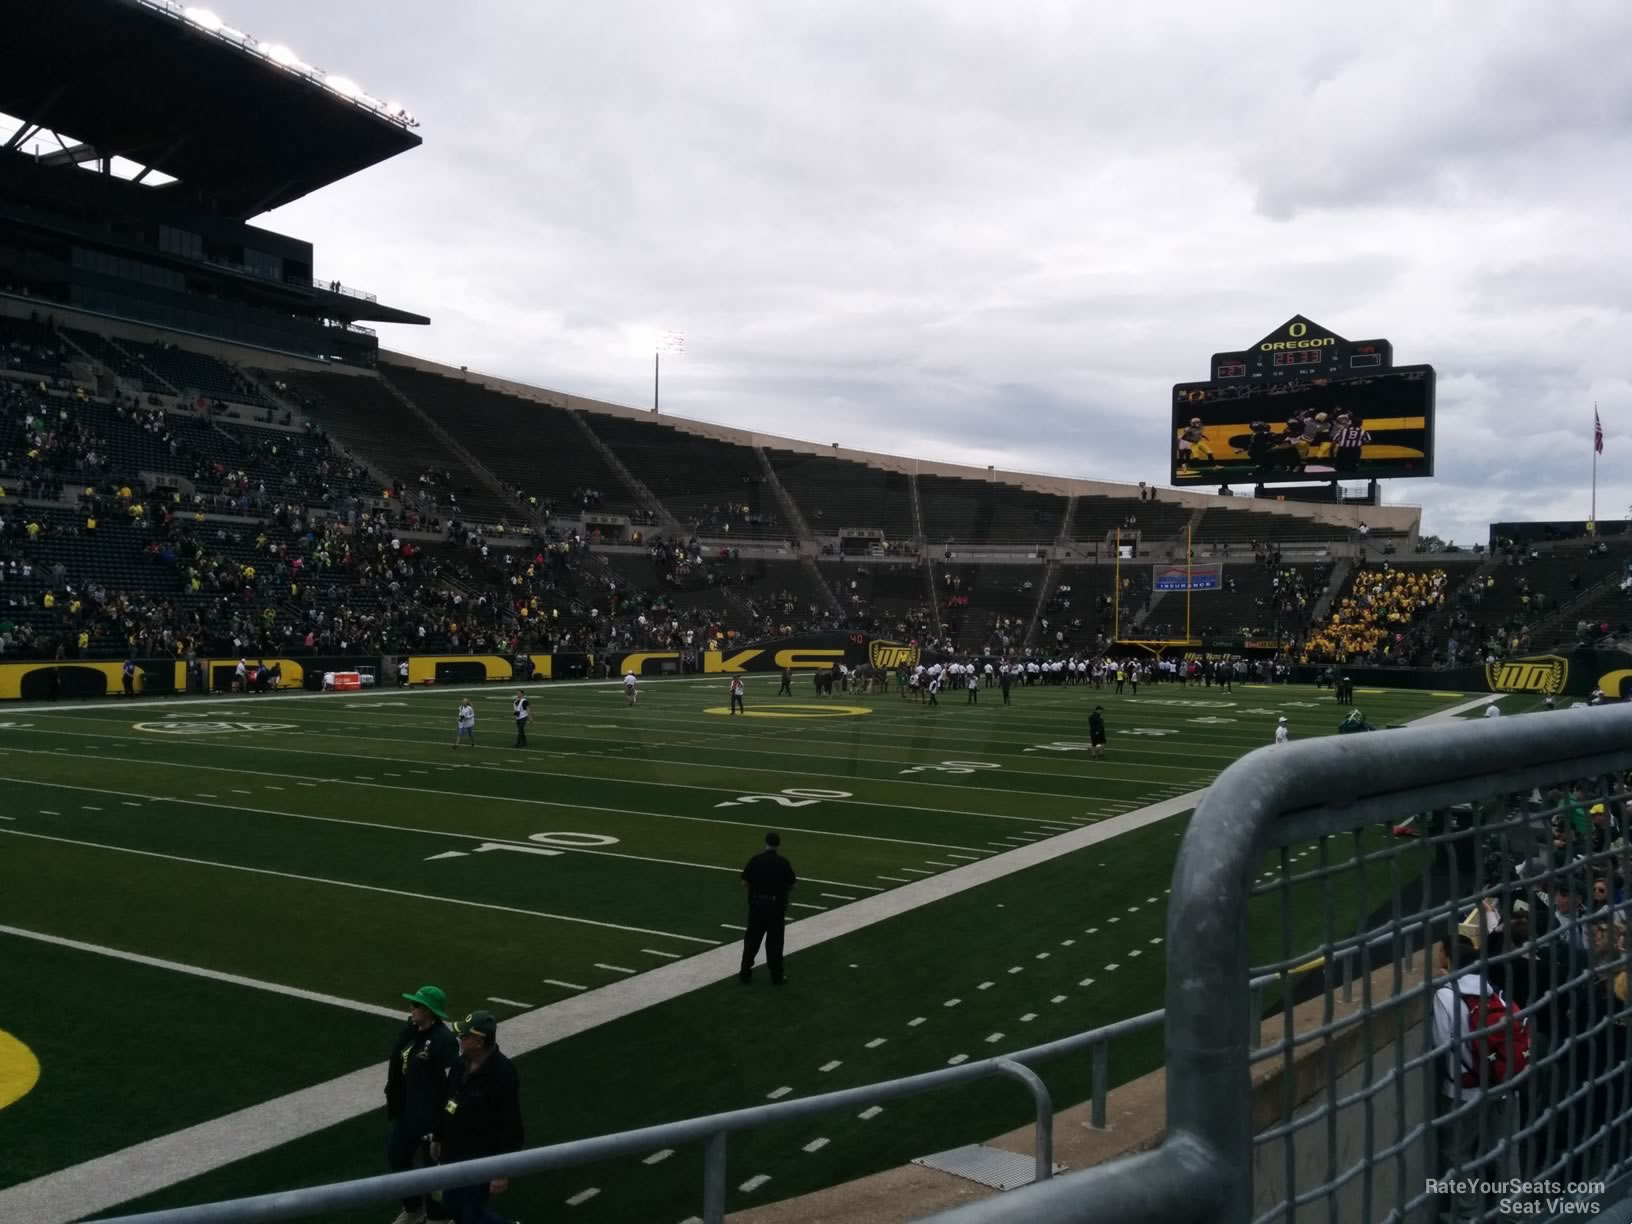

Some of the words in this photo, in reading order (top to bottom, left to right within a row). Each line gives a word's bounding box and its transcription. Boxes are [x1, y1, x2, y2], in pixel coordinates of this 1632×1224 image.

[1260, 337, 1335, 352] OREGON
[1160, 581, 1211, 589] INSURANCE
[736, 787, 854, 808] 20
[473, 831, 621, 857] 10
